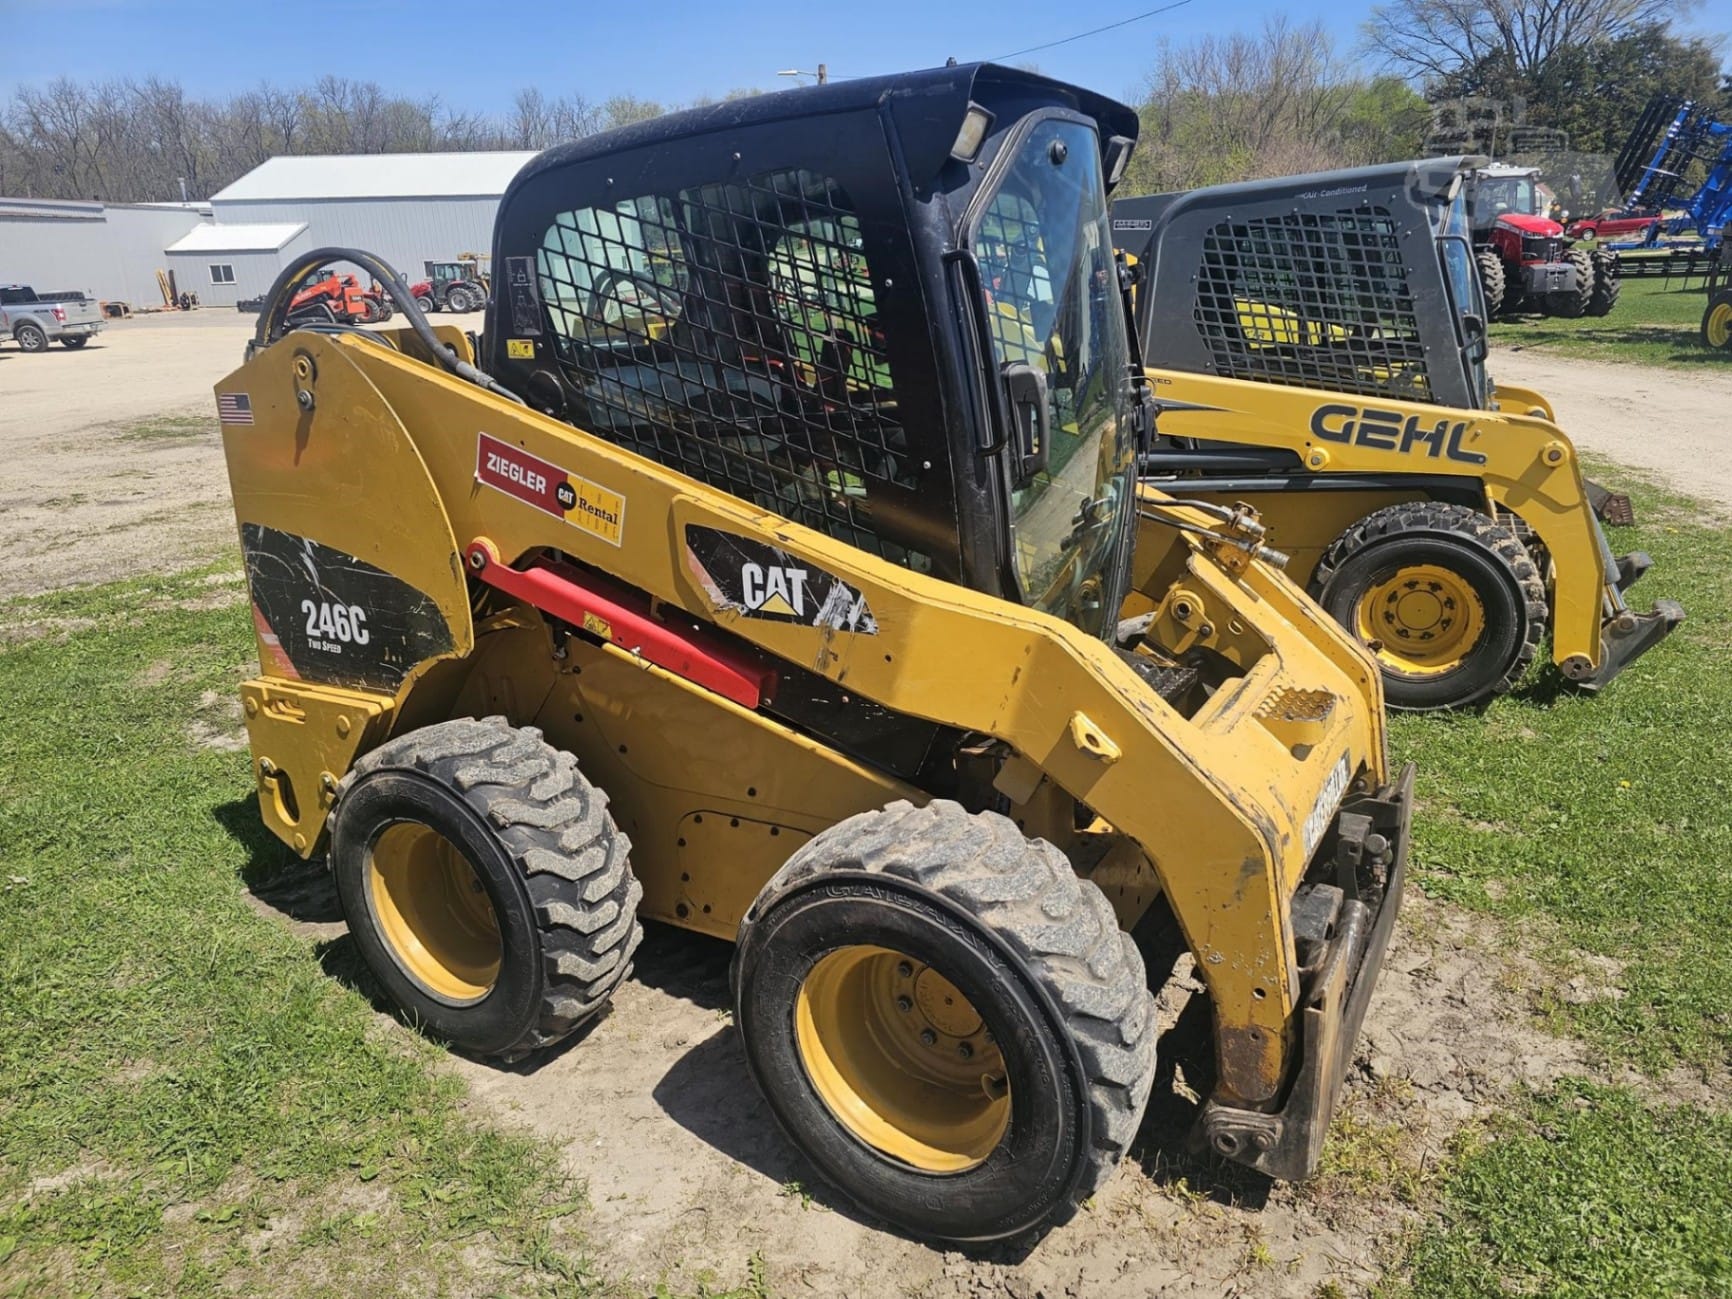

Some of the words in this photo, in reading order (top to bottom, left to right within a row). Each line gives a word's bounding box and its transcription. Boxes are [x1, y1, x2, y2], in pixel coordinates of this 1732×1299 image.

[1310, 404, 1487, 464] GEHL
[486, 452, 547, 495] ZIEGLER
[557, 487, 574, 505] CAT
[578, 497, 618, 525] Rental
[741, 562, 808, 617] CAT
[301, 599, 370, 646] 246C
